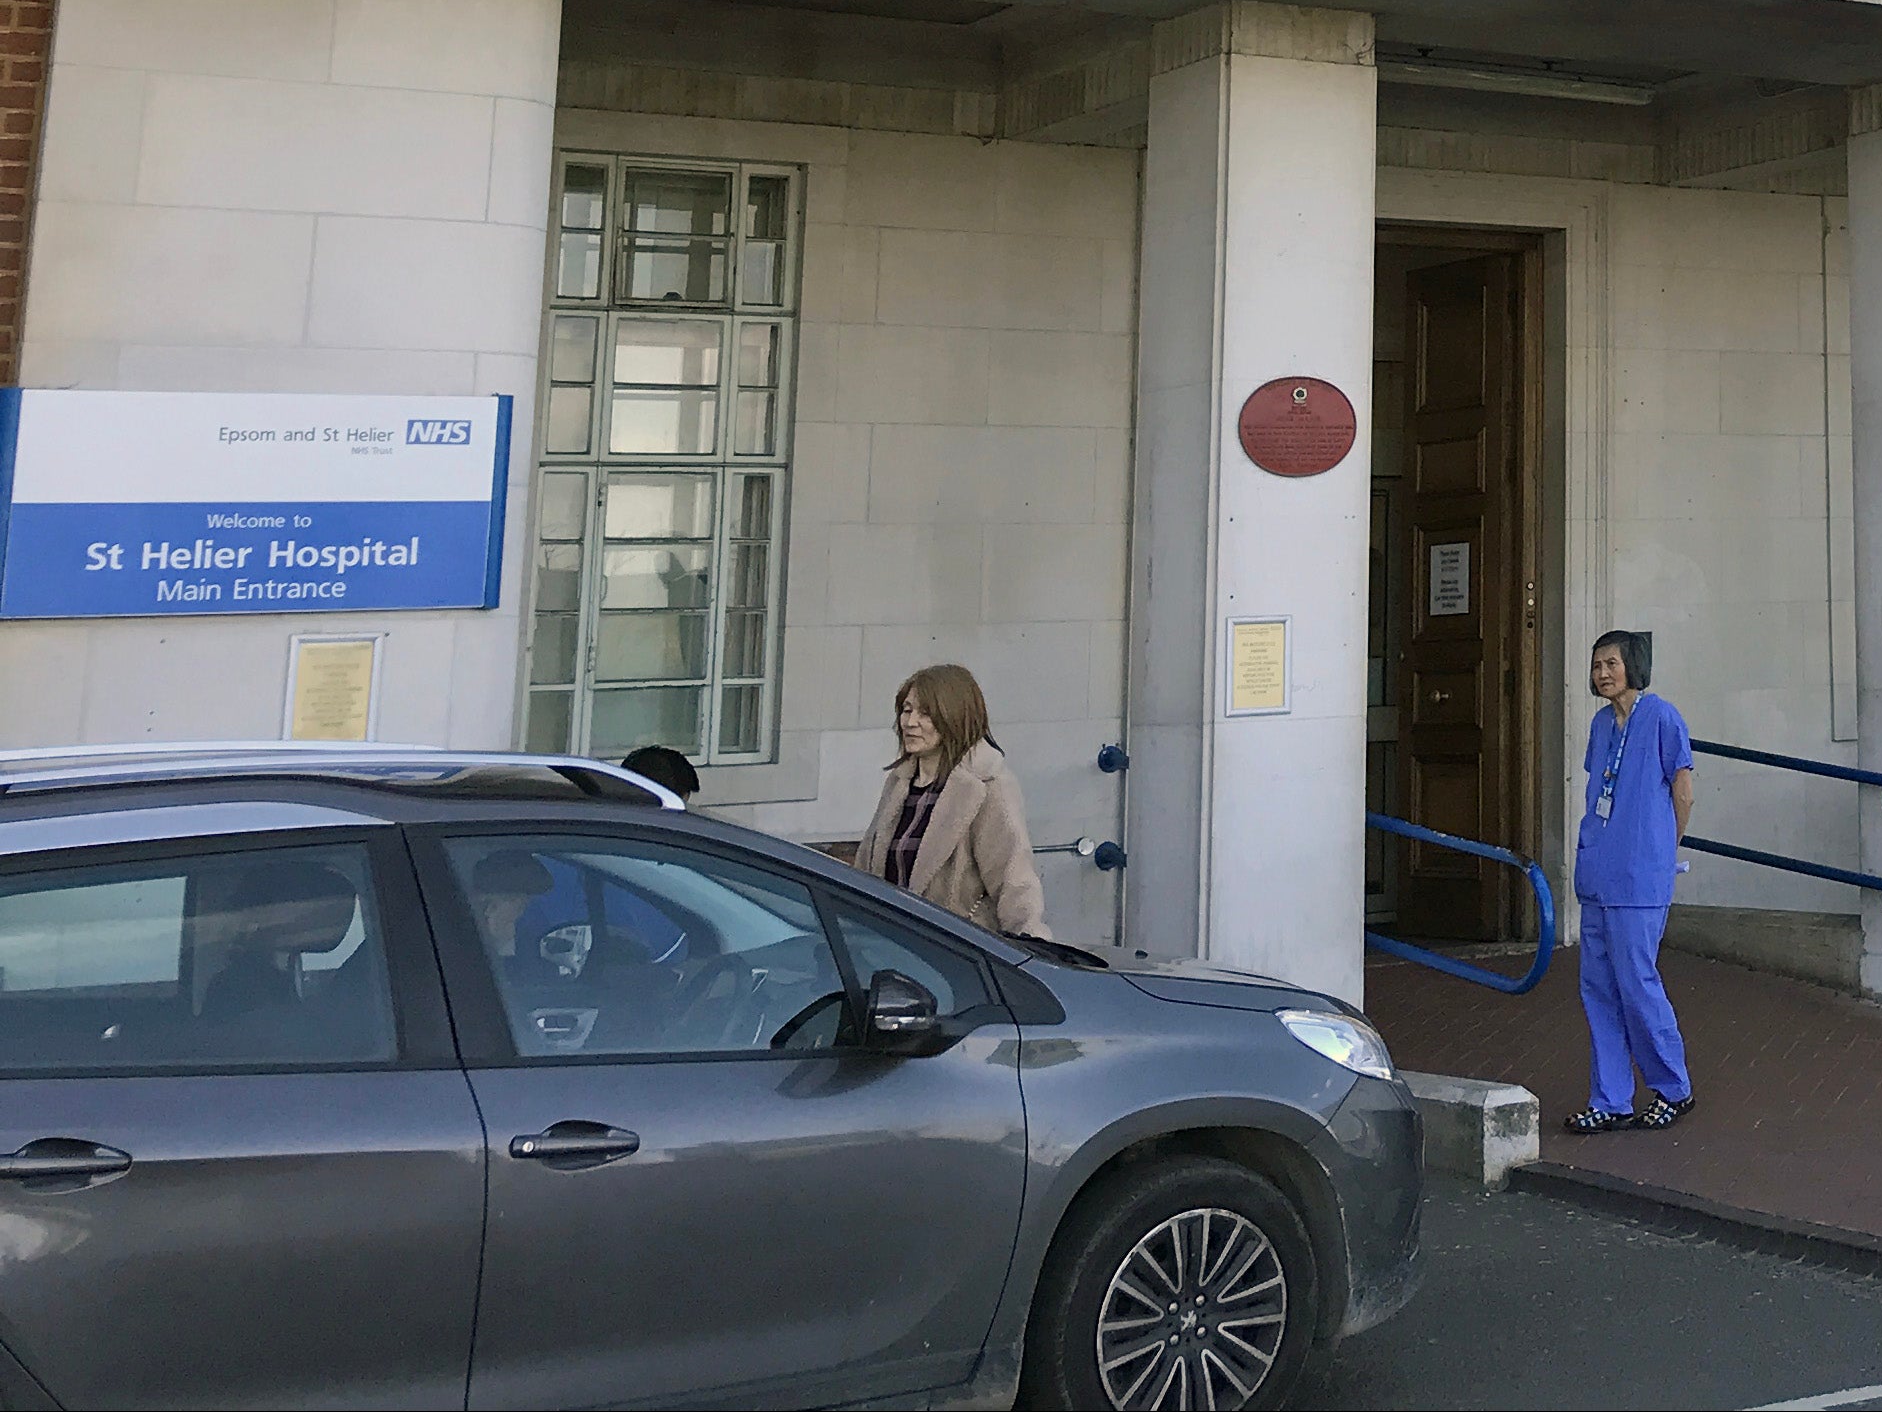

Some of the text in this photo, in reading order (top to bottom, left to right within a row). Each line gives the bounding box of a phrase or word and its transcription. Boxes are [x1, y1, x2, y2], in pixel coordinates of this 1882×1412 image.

[219, 427, 394, 445] Epsom and St Helier
[410, 420, 469, 443] NHS
[208, 514, 311, 528] Welcome to
[86, 537, 418, 573] St Helier Hospital
[157, 579, 346, 601] Main Entrance
